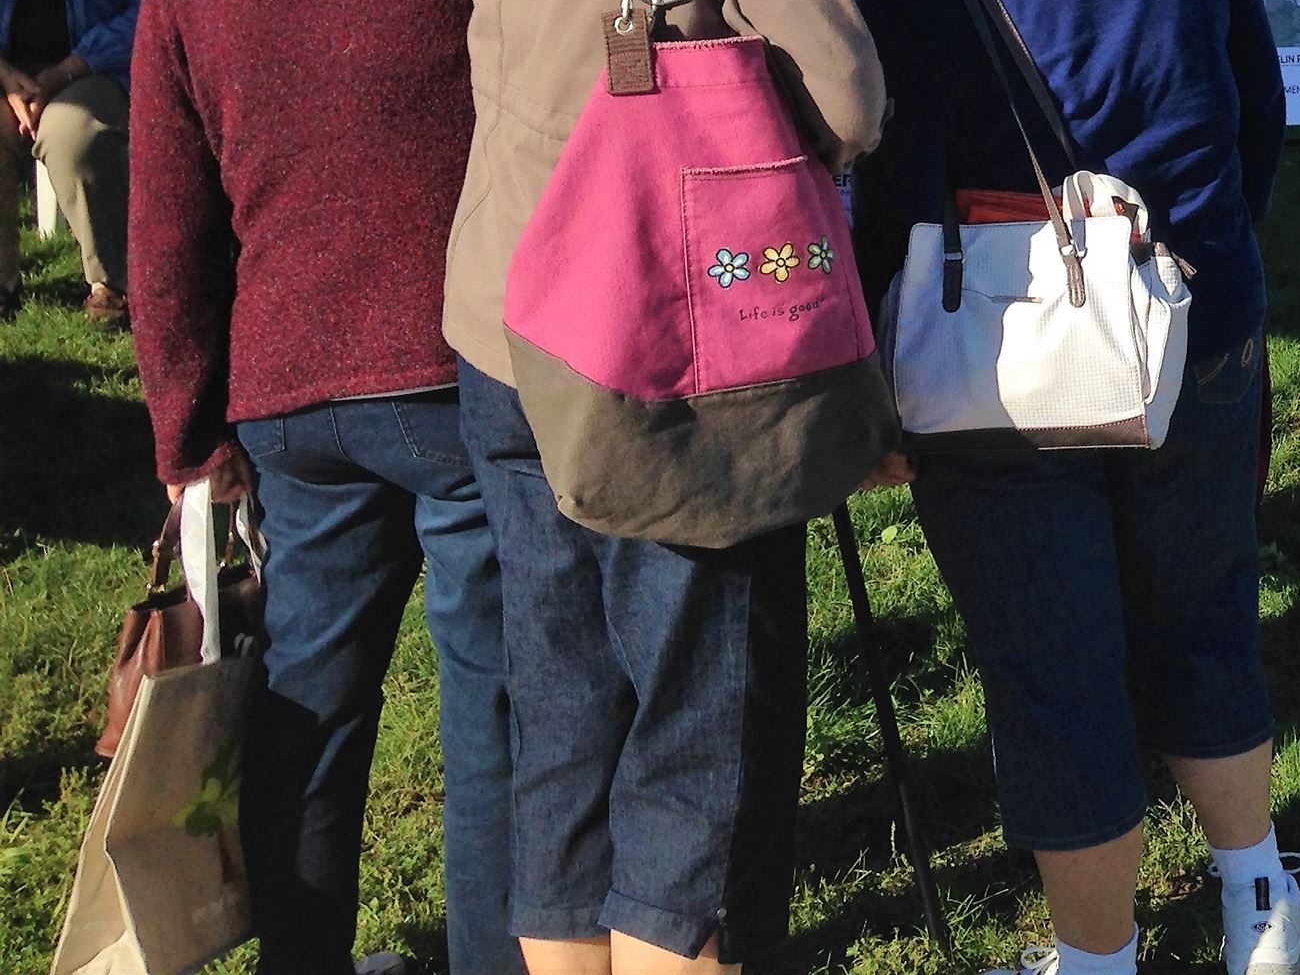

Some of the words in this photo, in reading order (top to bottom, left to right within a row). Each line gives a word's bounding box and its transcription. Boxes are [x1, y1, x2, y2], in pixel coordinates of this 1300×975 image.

[1278, 55, 1295, 63] LIN
[739, 306, 768, 321] Life
[772, 306, 785, 317] is
